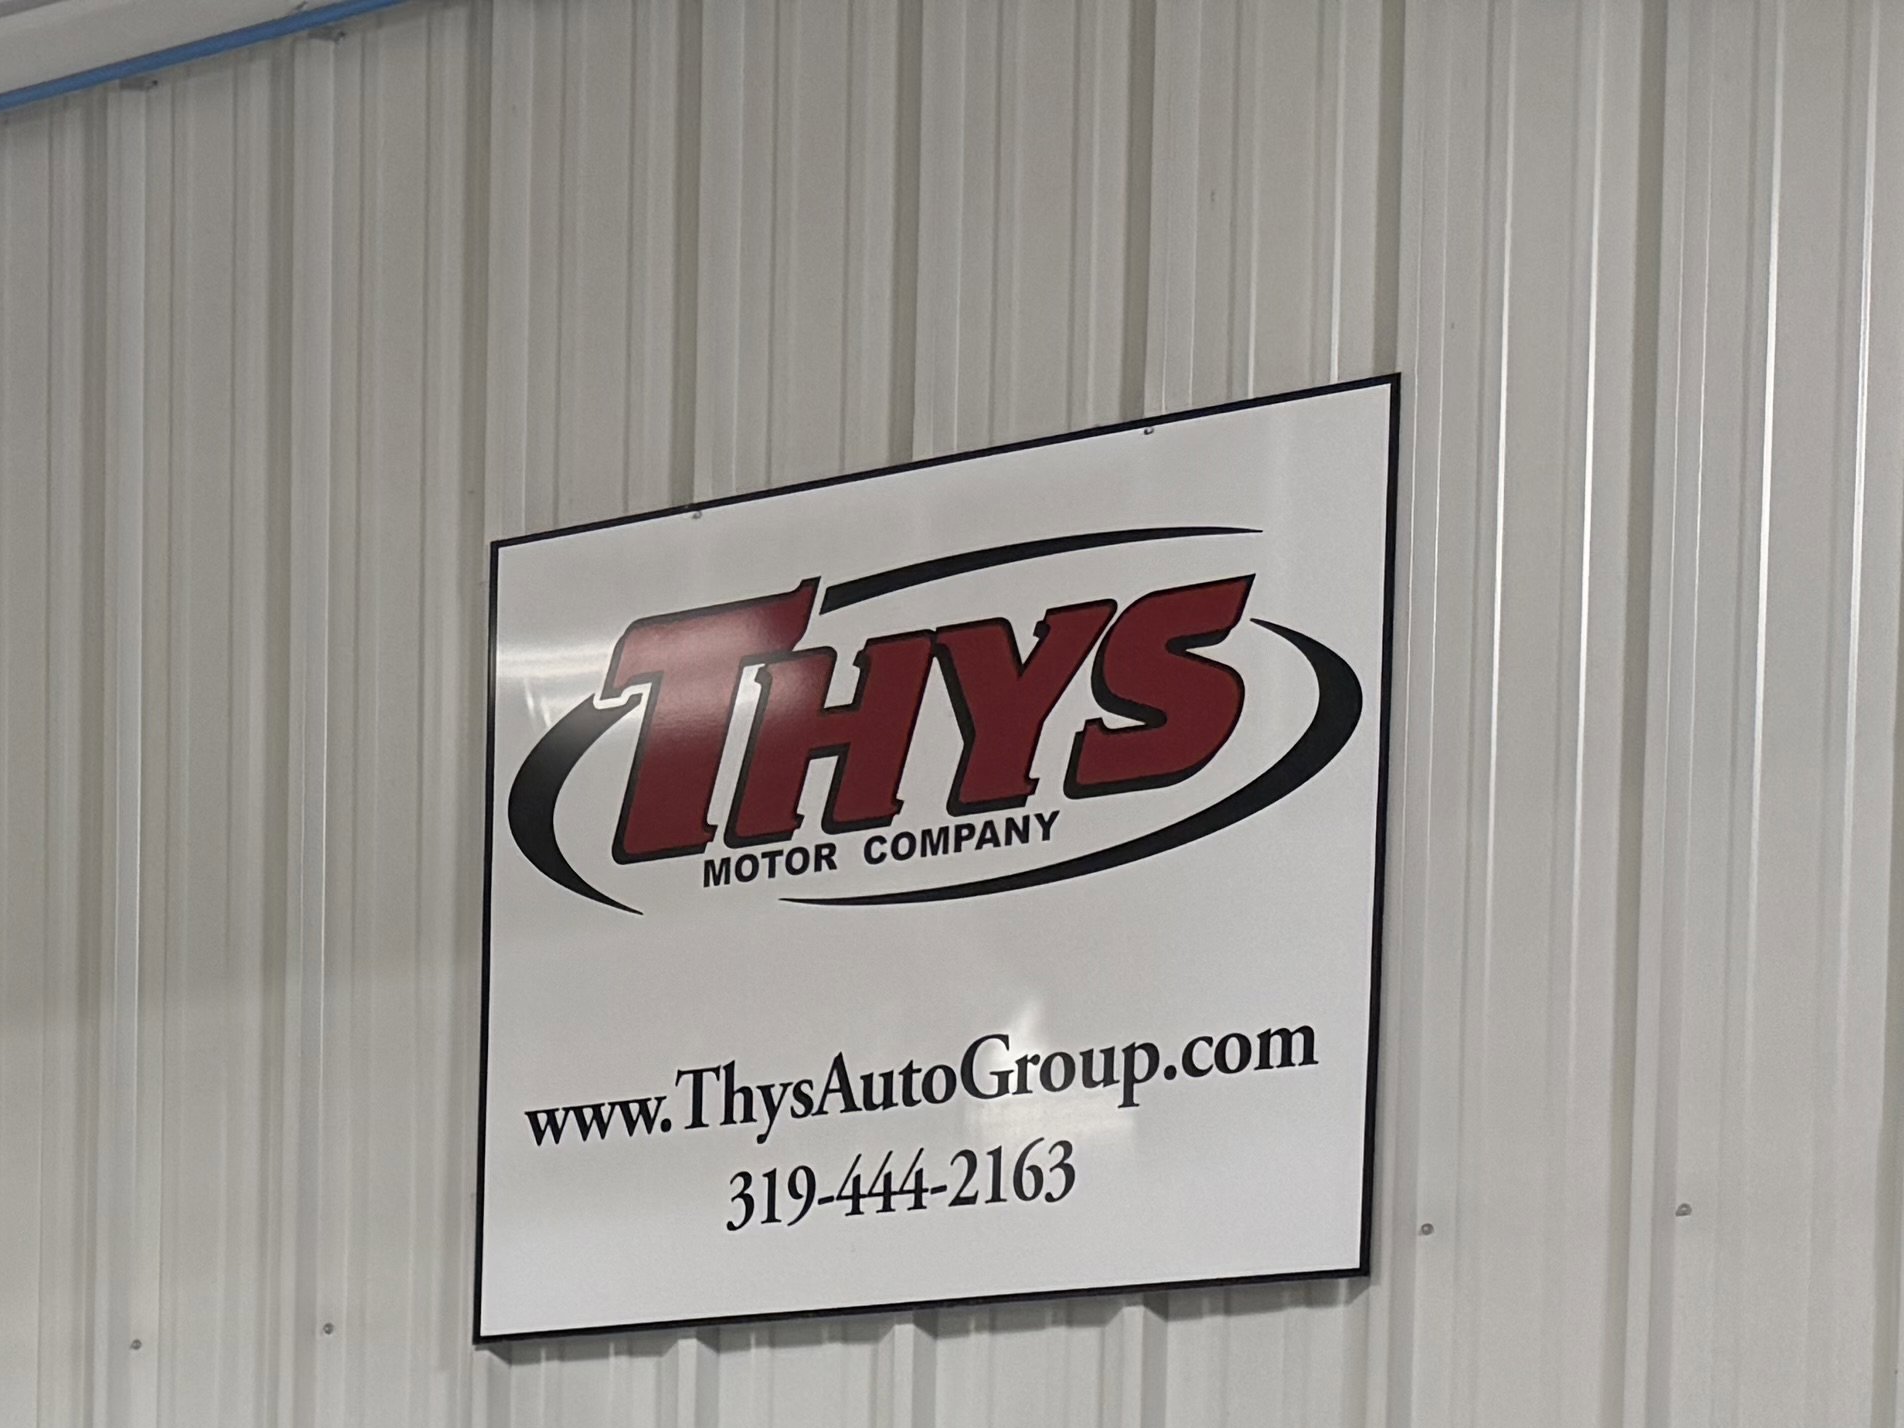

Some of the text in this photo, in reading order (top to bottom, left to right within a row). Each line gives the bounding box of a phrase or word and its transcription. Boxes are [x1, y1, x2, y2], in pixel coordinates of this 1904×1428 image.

[701, 809, 1061, 889] MOTOR COMPANY
[523, 1021, 1320, 1149] www.ThysAutoGroup.com
[724, 1137, 1078, 1233] 319-444-2163
